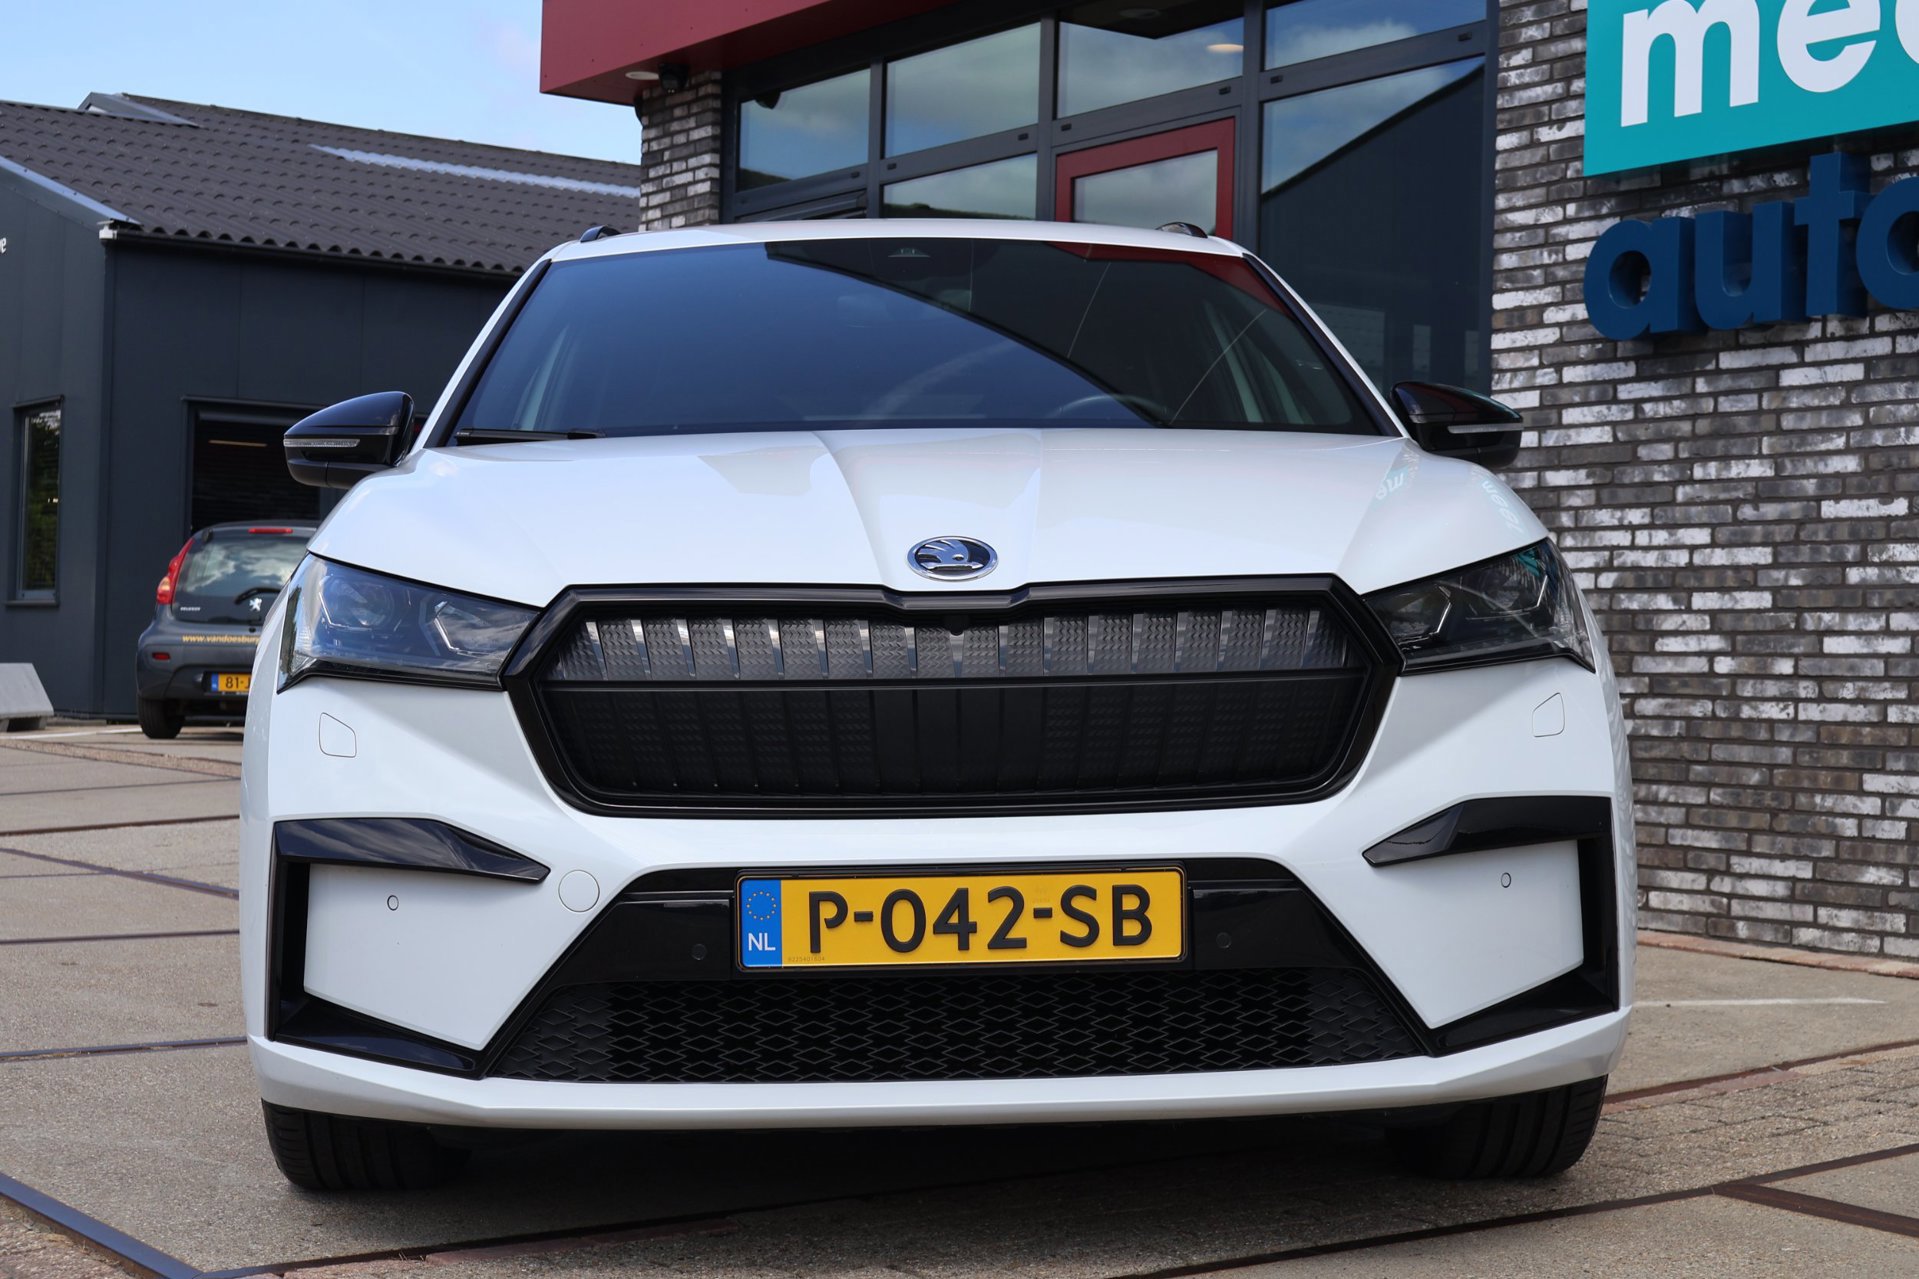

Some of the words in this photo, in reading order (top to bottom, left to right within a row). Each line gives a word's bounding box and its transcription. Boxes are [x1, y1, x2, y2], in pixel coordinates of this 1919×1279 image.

[1620, 0, 1919, 128] me
[1583, 152, 1919, 341] auto
[748, 932, 776, 951] NL
[808, 884, 1153, 953] P-042-SB
